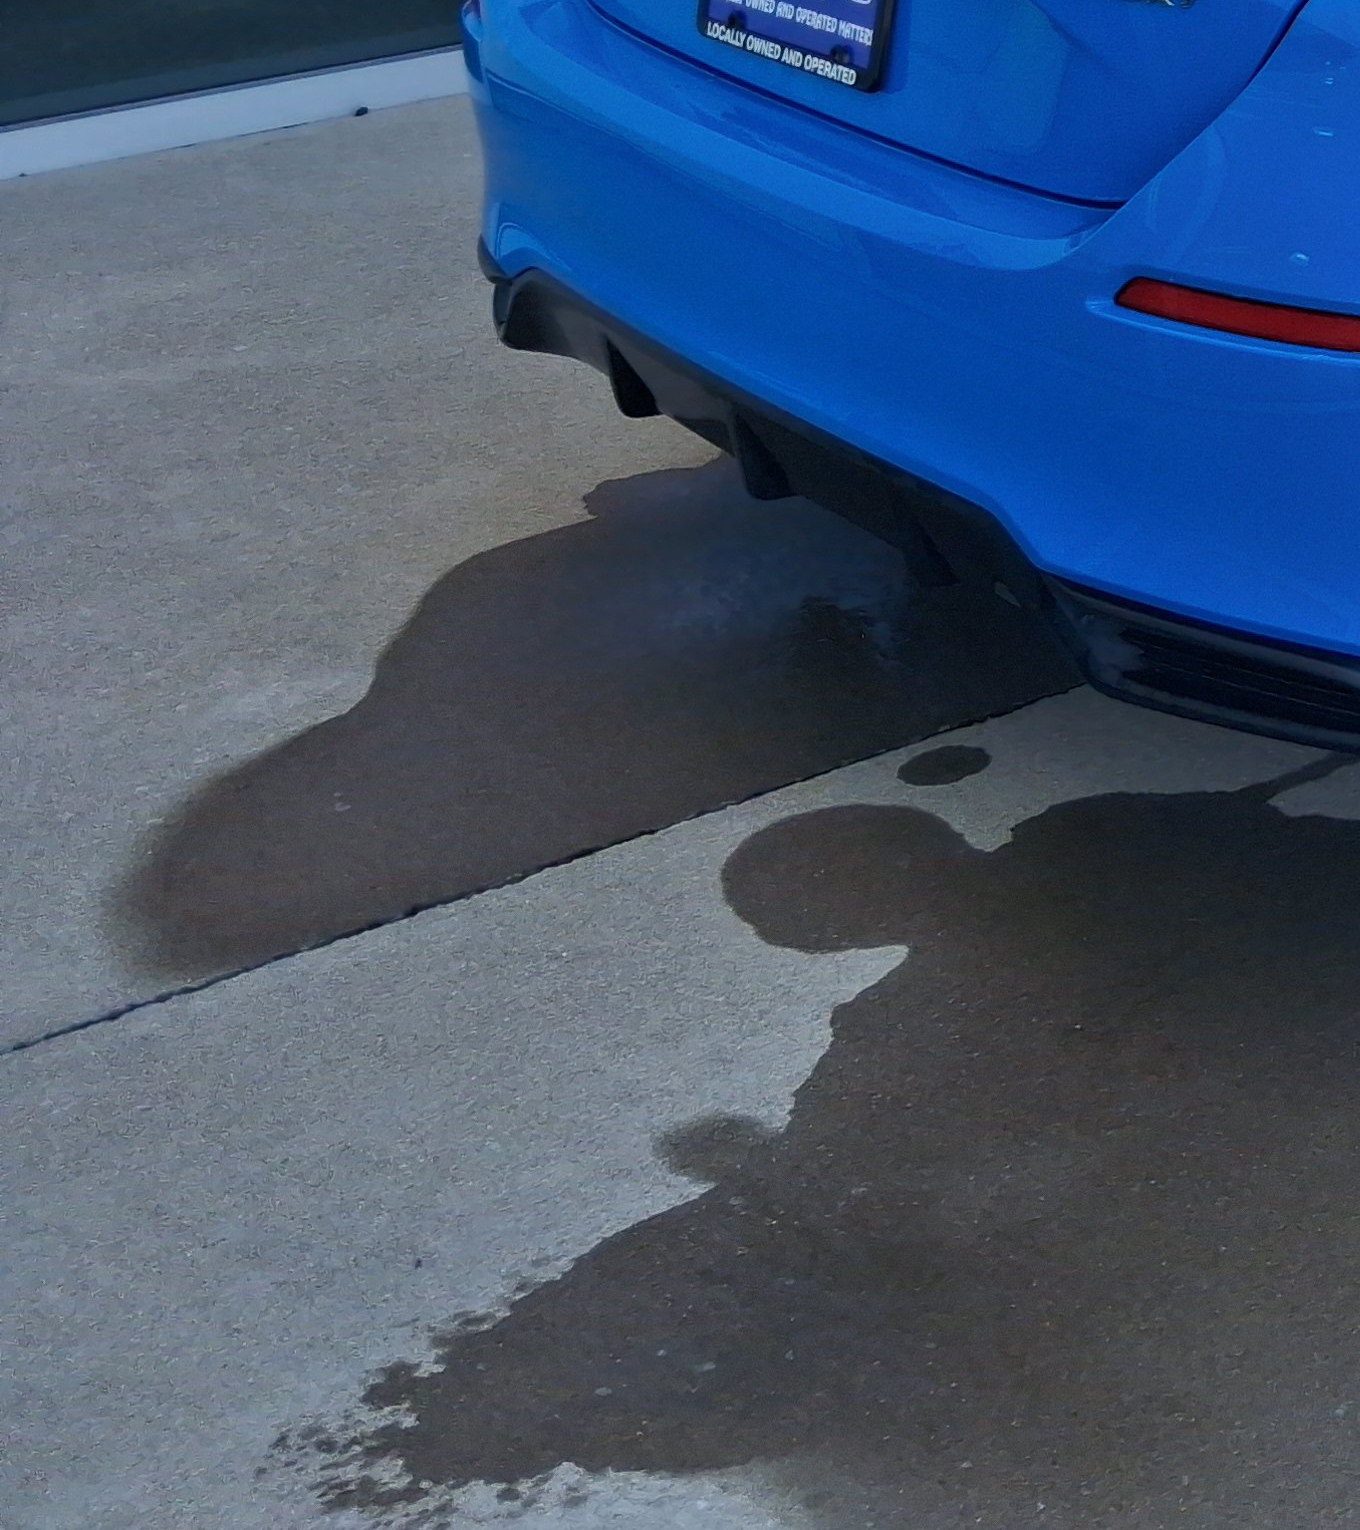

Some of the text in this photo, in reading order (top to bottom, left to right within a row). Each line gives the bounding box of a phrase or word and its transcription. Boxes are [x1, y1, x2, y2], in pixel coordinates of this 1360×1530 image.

[776, 1, 794, 19] AND
[796, 7, 838, 33] OPERATED
[707, 22, 856, 85] LOCALLY OWNED AND OPERATED
